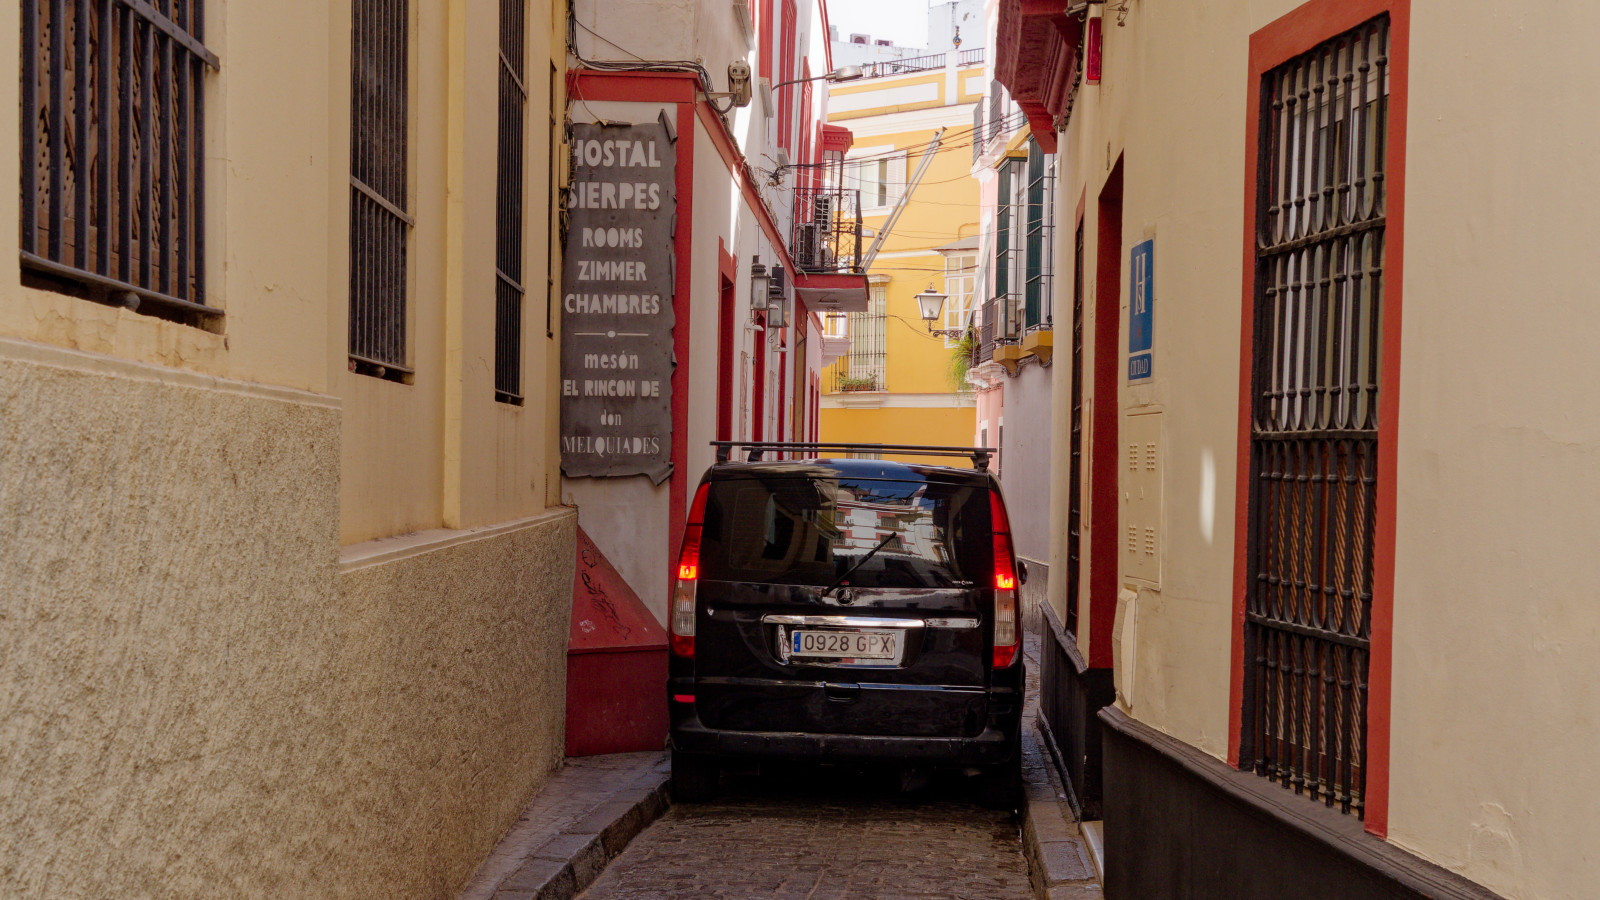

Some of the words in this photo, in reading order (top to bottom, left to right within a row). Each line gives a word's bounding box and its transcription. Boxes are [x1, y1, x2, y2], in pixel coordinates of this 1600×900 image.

[575, 140, 660, 167] HOSTAL
[568, 182, 660, 210] SIERPES
[583, 227, 643, 248] ROOMS
[578, 261, 647, 281] ZIMMER
[565, 294, 660, 315] CHAMBRES
[584, 350, 639, 370] mesón
[563, 380, 579, 396] EL
[584, 380, 636, 397] RINCON
[641, 381, 660, 397] DE
[600, 409, 622, 426] don
[562, 436, 660, 457] MELQUIADES
[804, 634, 850, 652] 0928
[856, 636, 890, 653] GPX
